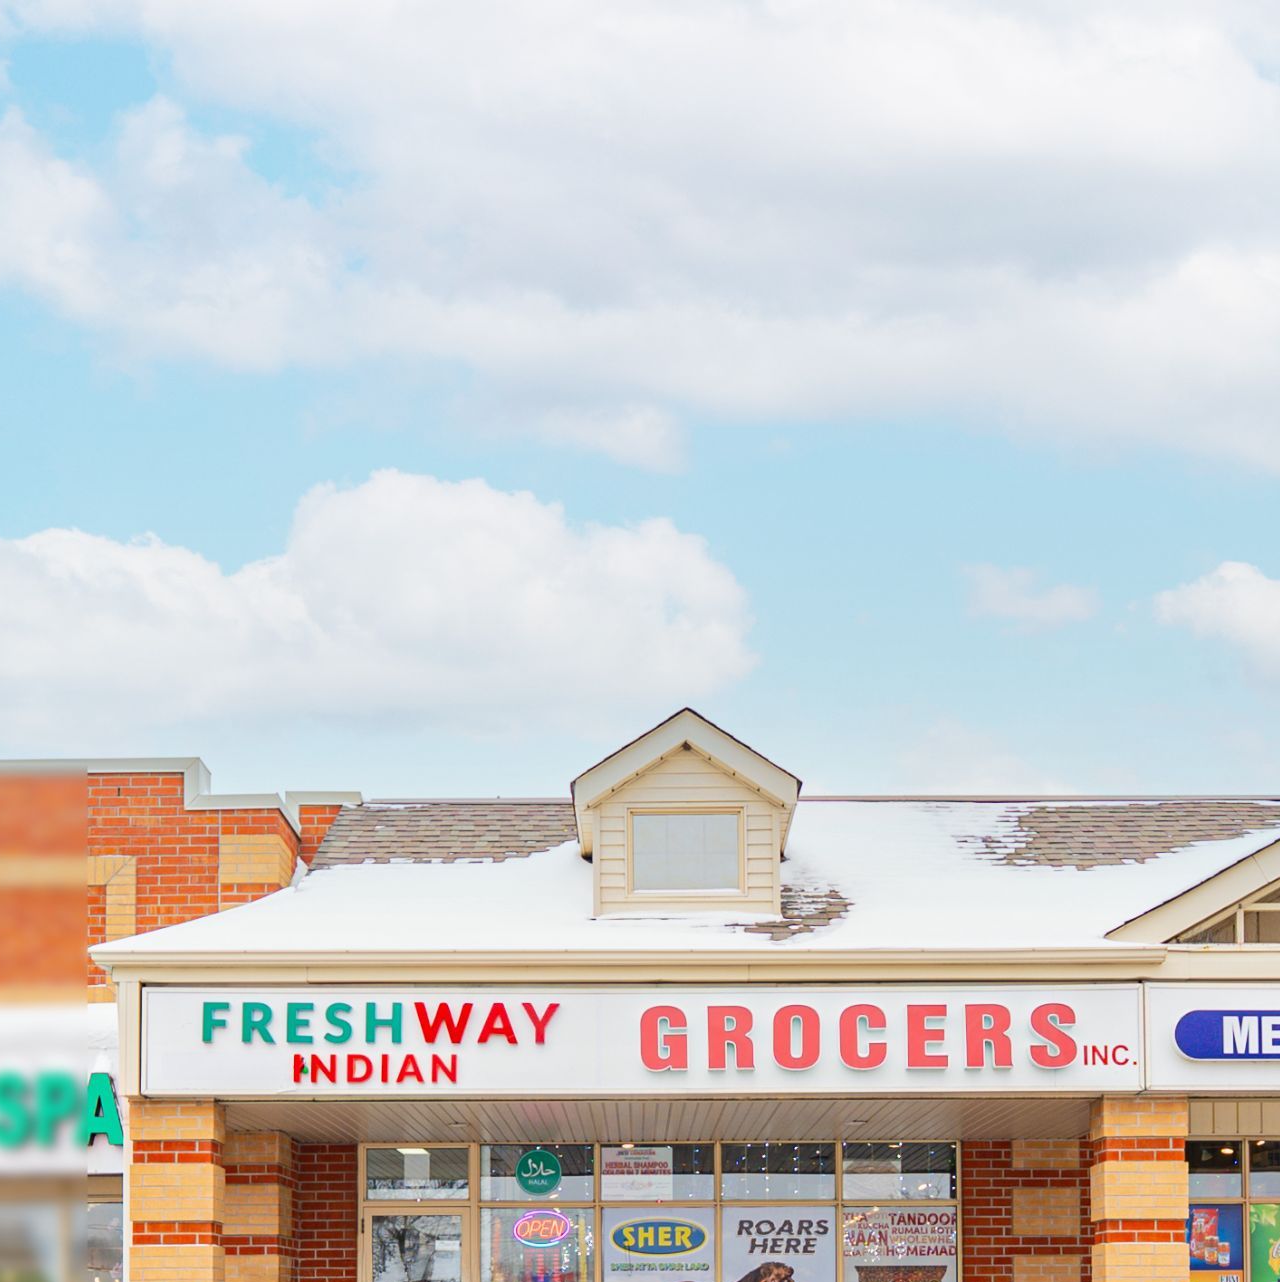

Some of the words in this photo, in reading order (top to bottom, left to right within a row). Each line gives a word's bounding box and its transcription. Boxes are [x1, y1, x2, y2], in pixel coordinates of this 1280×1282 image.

[202, 1001, 560, 1045] FRESHWAY
[639, 1001, 1078, 1072] GROCERS
[1083, 1044, 1138, 1066] INC.
[292, 1053, 459, 1084] INDIAN
[521, 1158, 556, 1179] حلال
[528, 1178, 549, 1186] HALAL
[517, 1219, 565, 1239] OPEN
[622, 1227, 693, 1249] SHER
[737, 1219, 830, 1236] ROARS
[748, 1237, 818, 1254] HERE
